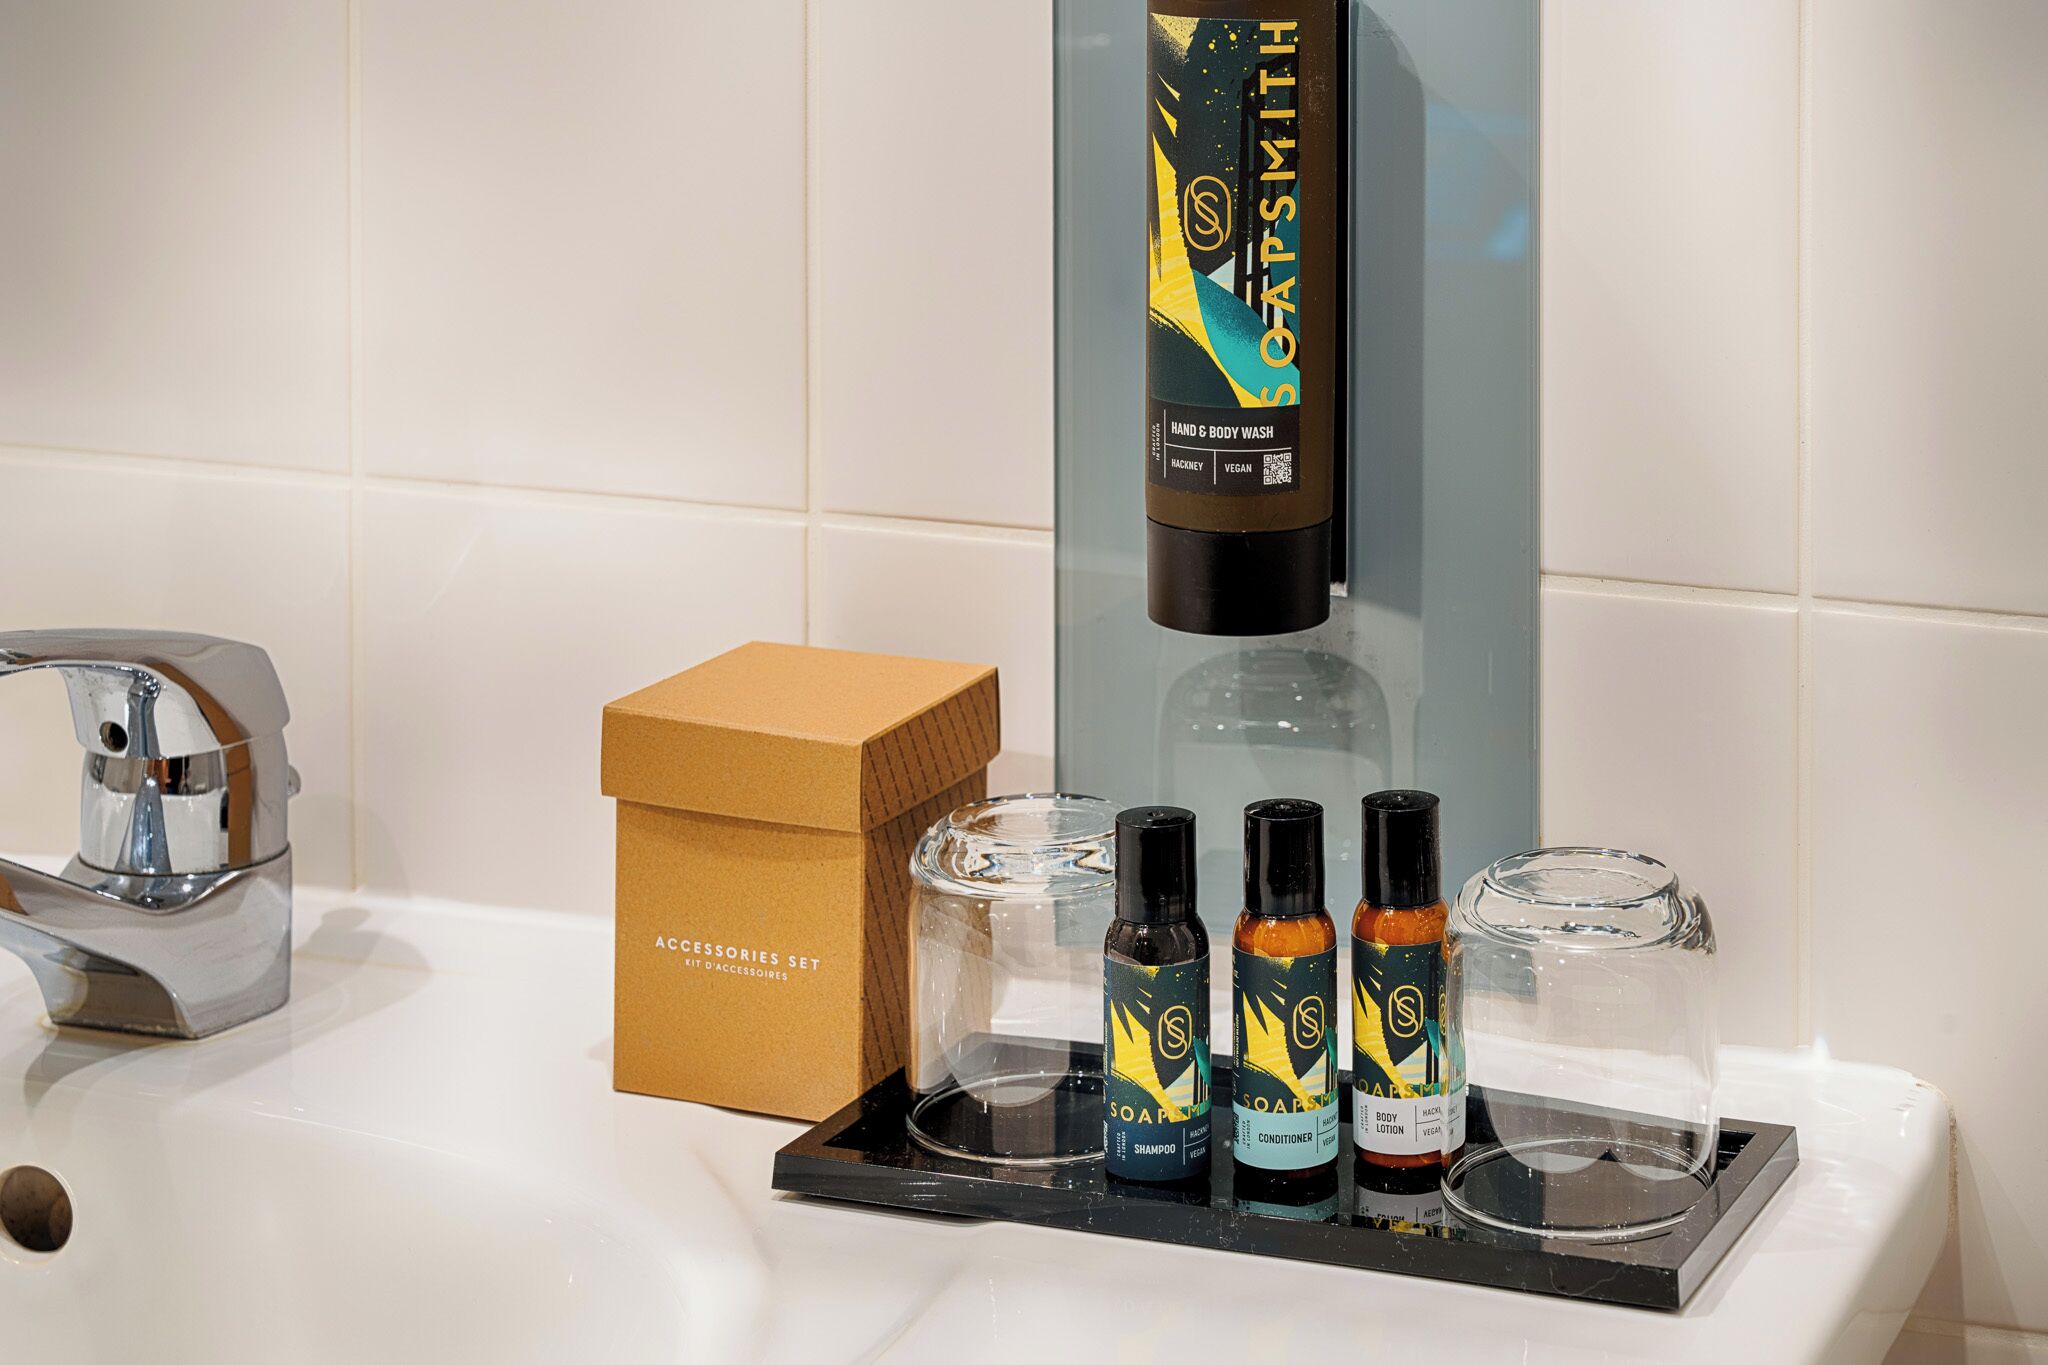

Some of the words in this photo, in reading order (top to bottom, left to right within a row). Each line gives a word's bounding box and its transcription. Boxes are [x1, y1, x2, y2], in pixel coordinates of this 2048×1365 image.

[1260, 21, 1297, 407] SOAPSMITH
[1171, 421, 1197, 437] HAND
[1199, 425, 1207, 437] &
[1209, 426, 1239, 439] BODY
[1242, 426, 1274, 439] WASH
[1171, 458, 1204, 471] HACKNEY
[1224, 463, 1252, 473] VEGAN
[655, 936, 779, 965] ACCESSORIES
[788, 955, 820, 971] SET
[685, 959, 701, 968] KIT
[705, 962, 788, 981] D'ACCESSOIRES
[1376, 1112, 1398, 1123] BODY
[1376, 1124, 1405, 1135] LOTION
[1258, 1132, 1313, 1144] CONDITIONER
[1134, 1144, 1176, 1155] SHAMPOO
